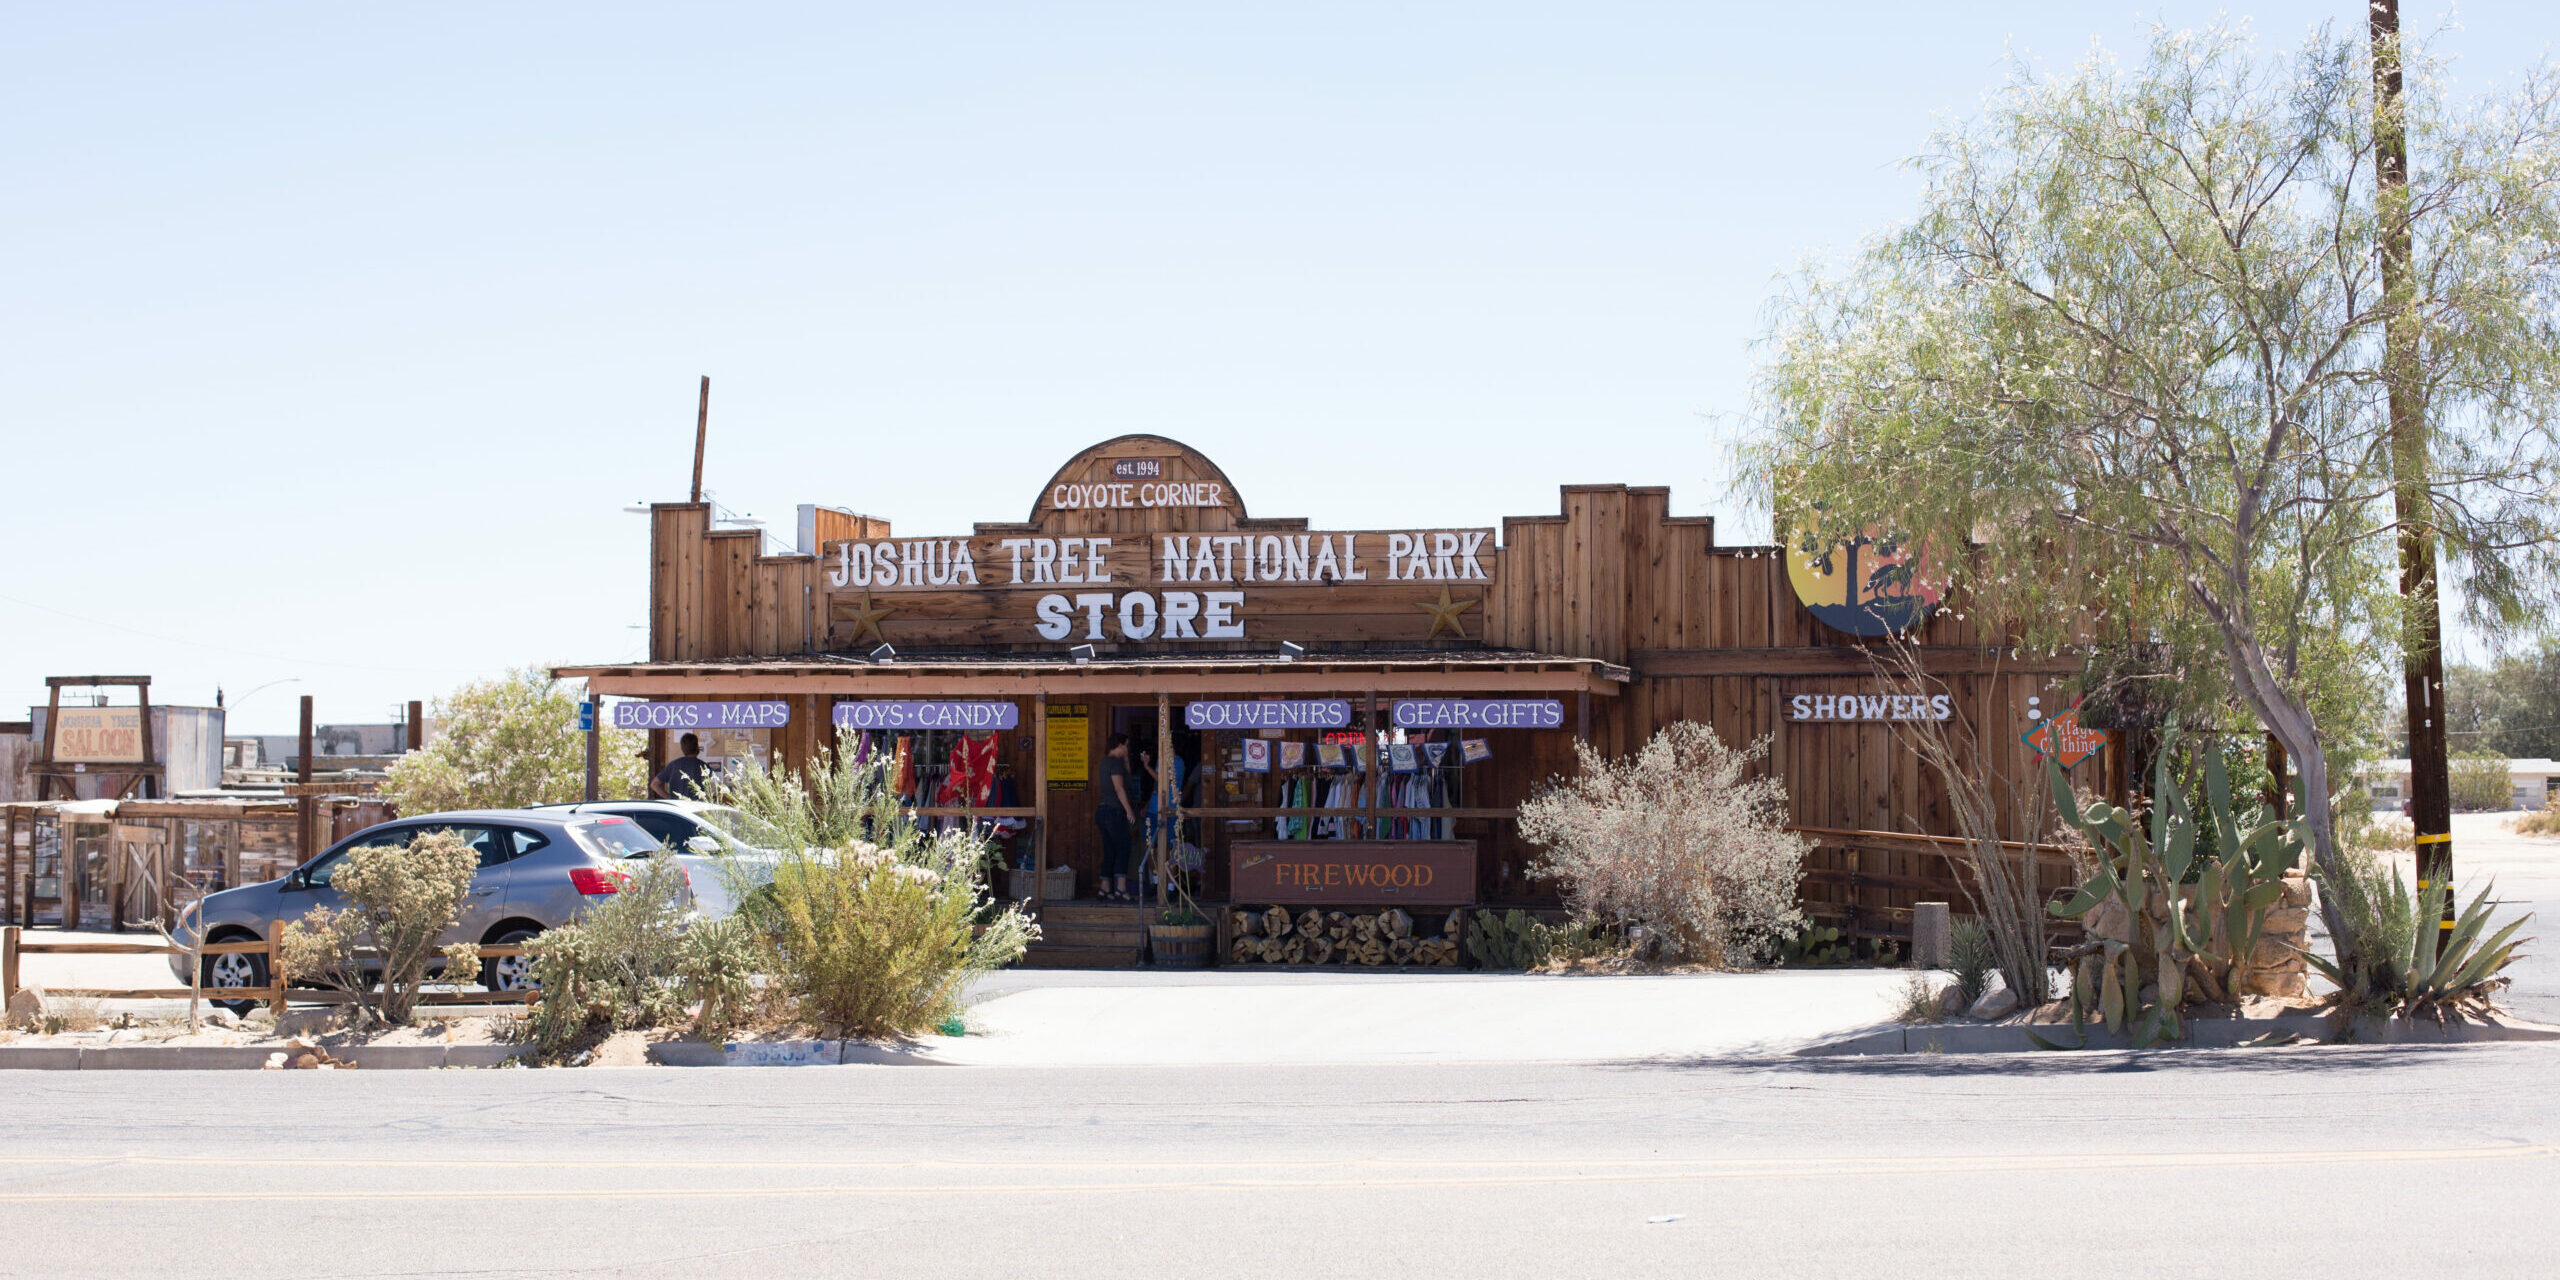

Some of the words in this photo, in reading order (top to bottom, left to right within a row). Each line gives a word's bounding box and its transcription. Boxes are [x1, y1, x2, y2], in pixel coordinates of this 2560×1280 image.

[1116, 461, 1134, 476] est.
[1137, 460, 1160, 476] 1994
[1054, 483, 1134, 509] COYOTE
[1141, 482, 1222, 508] CORNER
[829, 540, 979, 587] JOSHUA
[1001, 537, 1113, 584] TREE
[1162, 534, 1368, 583] NATIONAL
[1387, 531, 1488, 580] PARK
[1035, 590, 1245, 641] STORE
[619, 703, 698, 727] BOOKS
[721, 702, 788, 726] MAPS
[839, 702, 904, 727] TOYS
[918, 703, 1007, 727] CANDY
[1190, 701, 1344, 727] SOUVENIRS
[1395, 700, 1471, 726] GEAR
[1479, 701, 1561, 726] GIFTS
[1792, 694, 1950, 721] SHOWERS
[59, 715, 102, 728] JOSHUA
[111, 715, 138, 728] TREE
[62, 729, 135, 757] SALOON
[2040, 735, 2096, 756] Clthing
[1276, 863, 1433, 887] FIREWOOD
